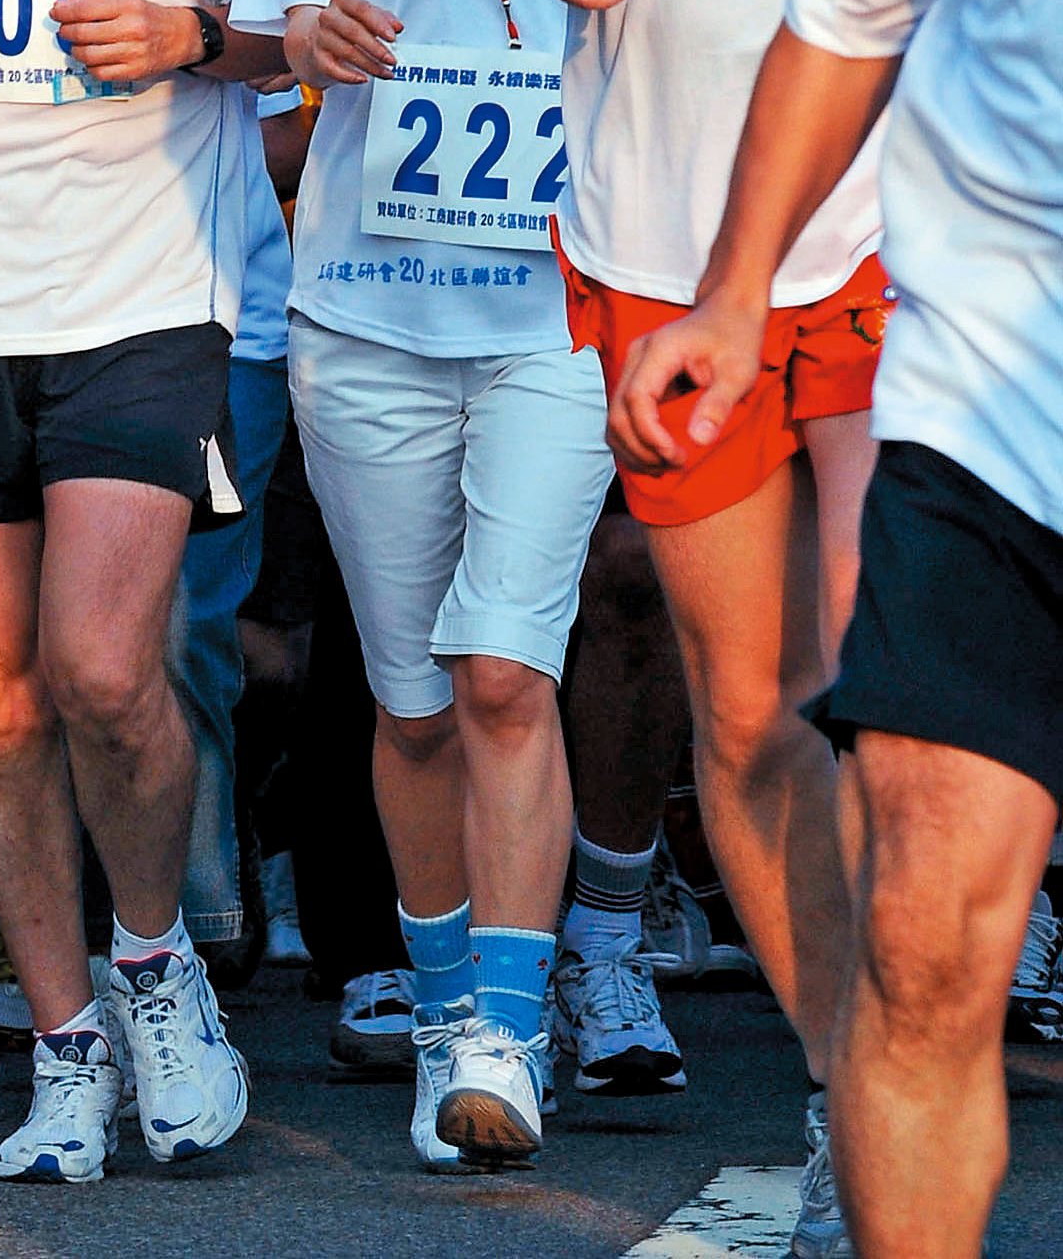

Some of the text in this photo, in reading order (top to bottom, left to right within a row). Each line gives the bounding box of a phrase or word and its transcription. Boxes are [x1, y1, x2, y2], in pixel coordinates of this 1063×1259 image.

[8, 70, 21, 82] 20
[392, 66, 561, 91] 世界無障礙 永續樂活
[392, 98, 569, 203] 222
[480, 214, 494, 226] 20
